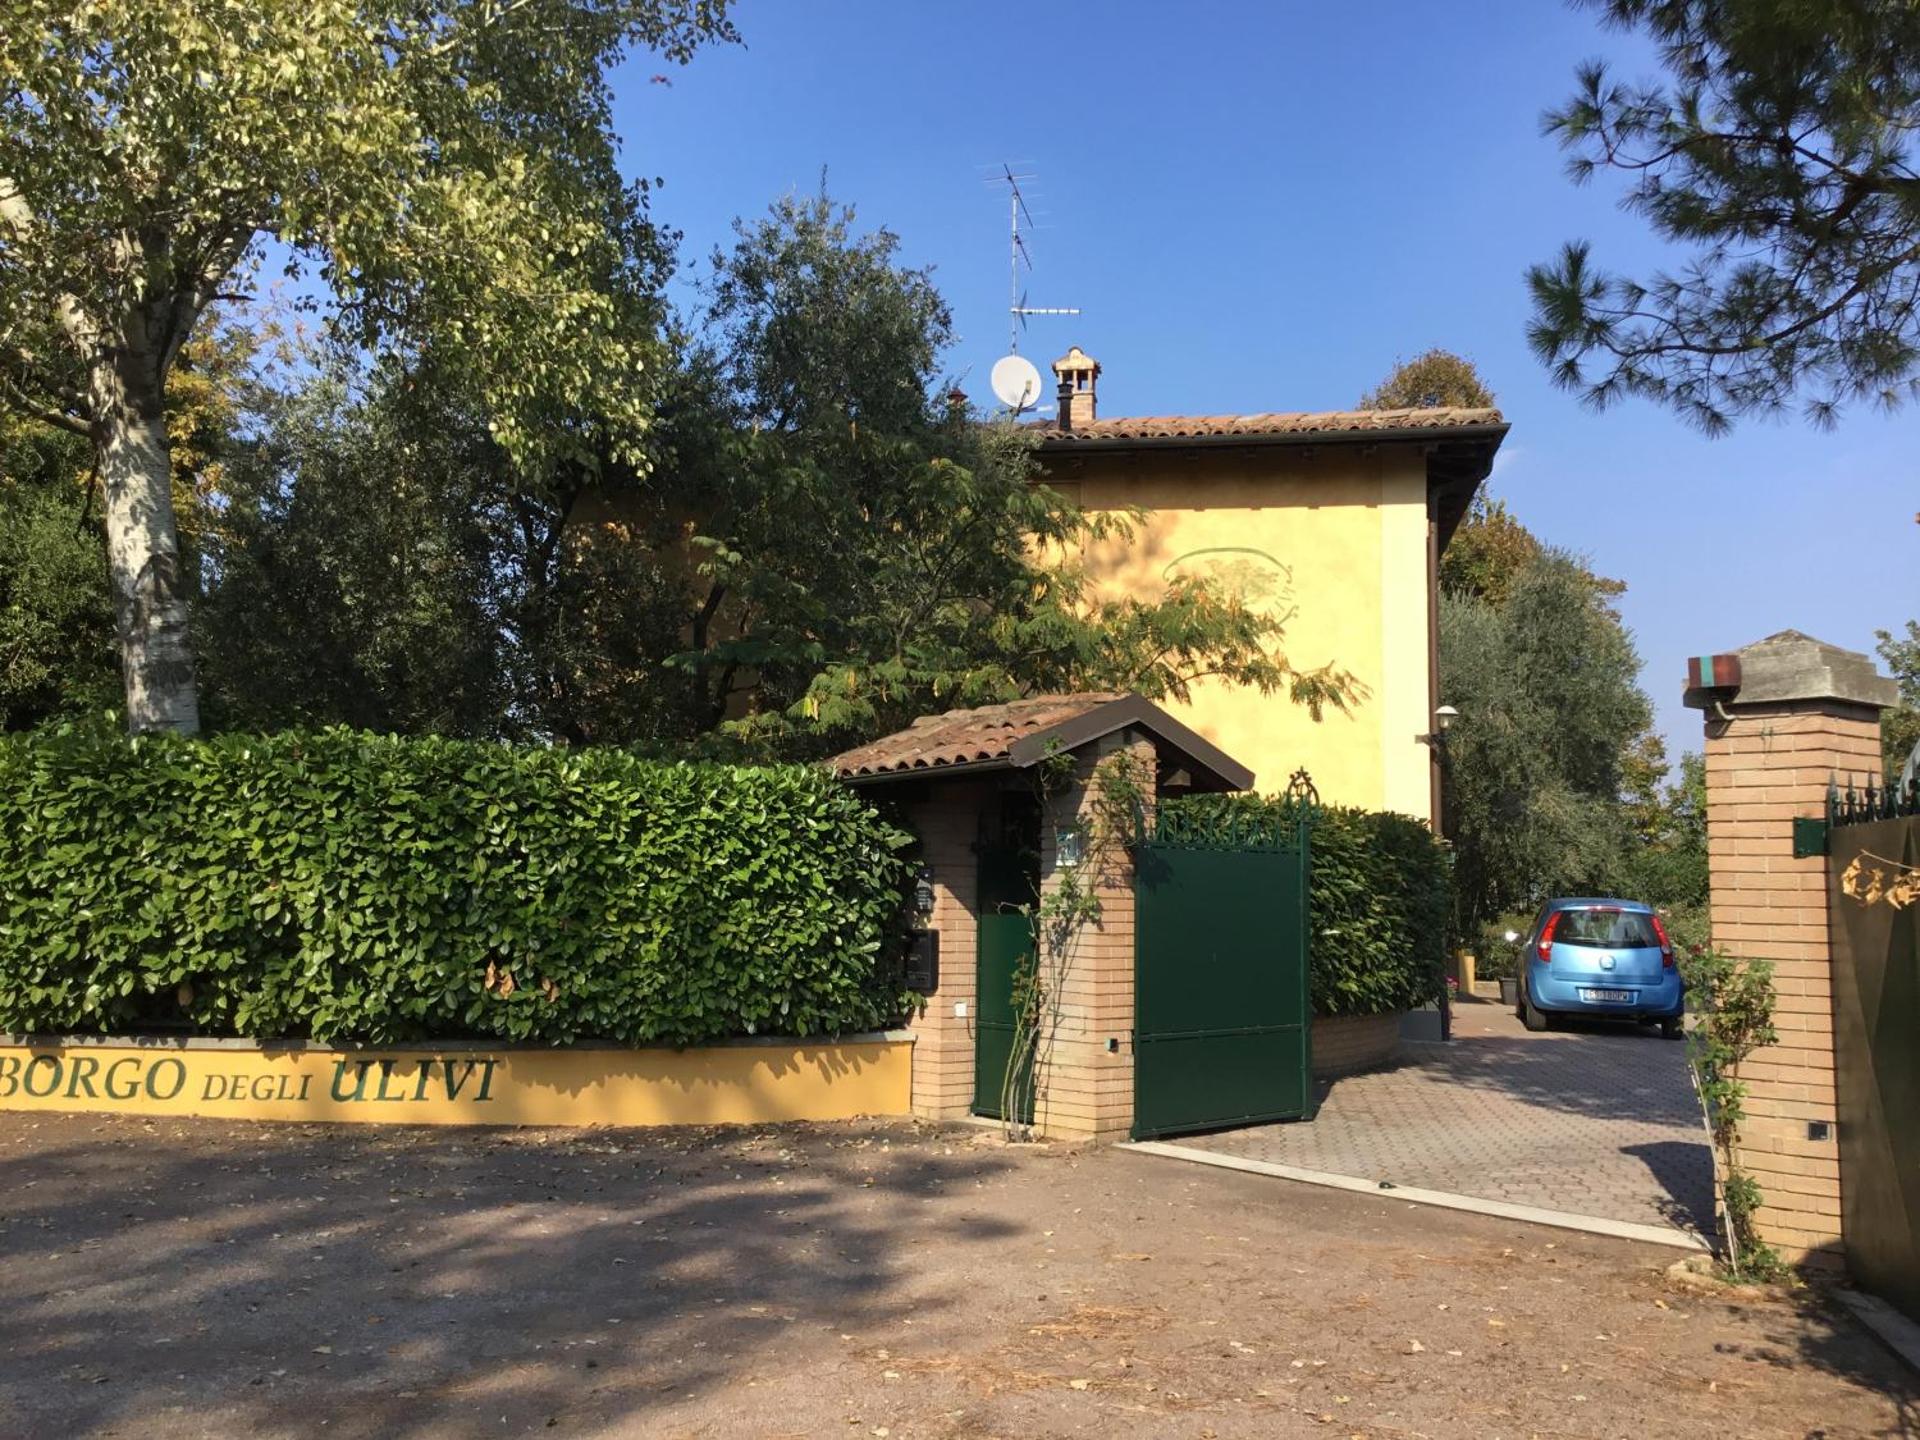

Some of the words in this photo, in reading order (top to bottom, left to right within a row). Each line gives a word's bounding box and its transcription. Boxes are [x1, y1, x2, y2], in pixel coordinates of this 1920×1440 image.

[0, 1055, 187, 1100] BORGO
[201, 1074, 313, 1101] DEGLI
[331, 1059, 499, 1102] ULIVI
